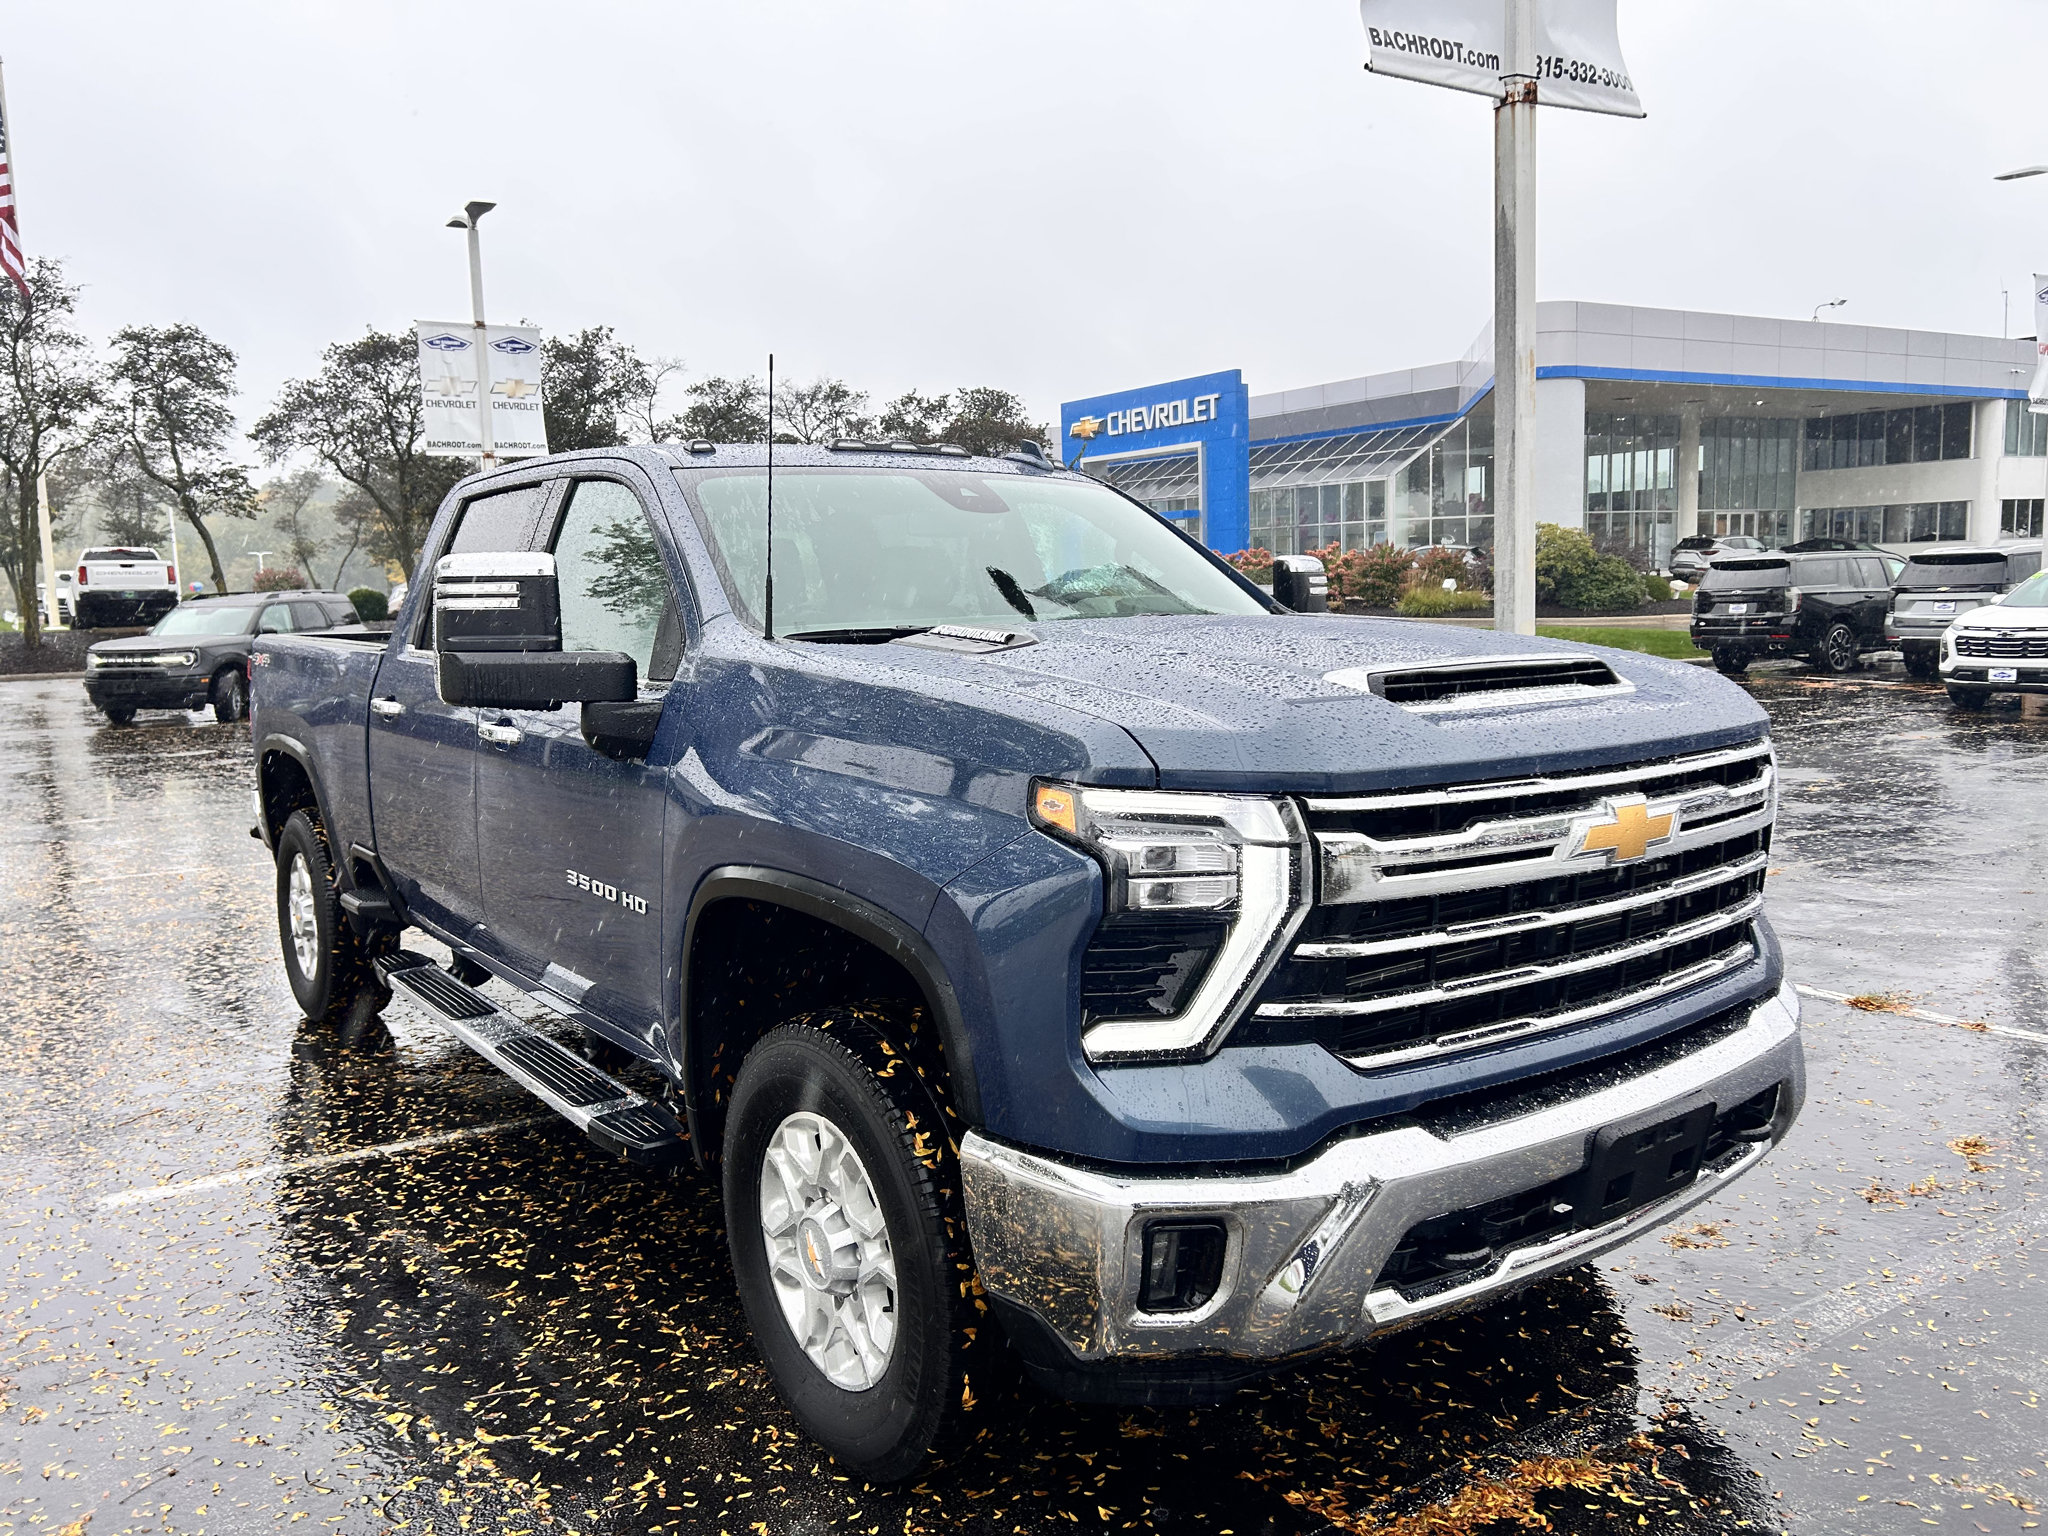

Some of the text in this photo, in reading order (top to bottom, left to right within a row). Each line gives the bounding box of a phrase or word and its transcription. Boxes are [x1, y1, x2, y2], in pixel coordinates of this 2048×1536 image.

[1368, 27, 1500, 71] BACHRODT.com
[426, 399, 477, 409] CHEVROLET
[492, 401, 540, 411] CHEVROLET
[1107, 393, 1221, 436] CHEVROLET
[427, 440, 482, 449] BACHRODT.com
[494, 441, 547, 450] BACHRODT.com
[566, 868, 647, 915] 3500 HD
